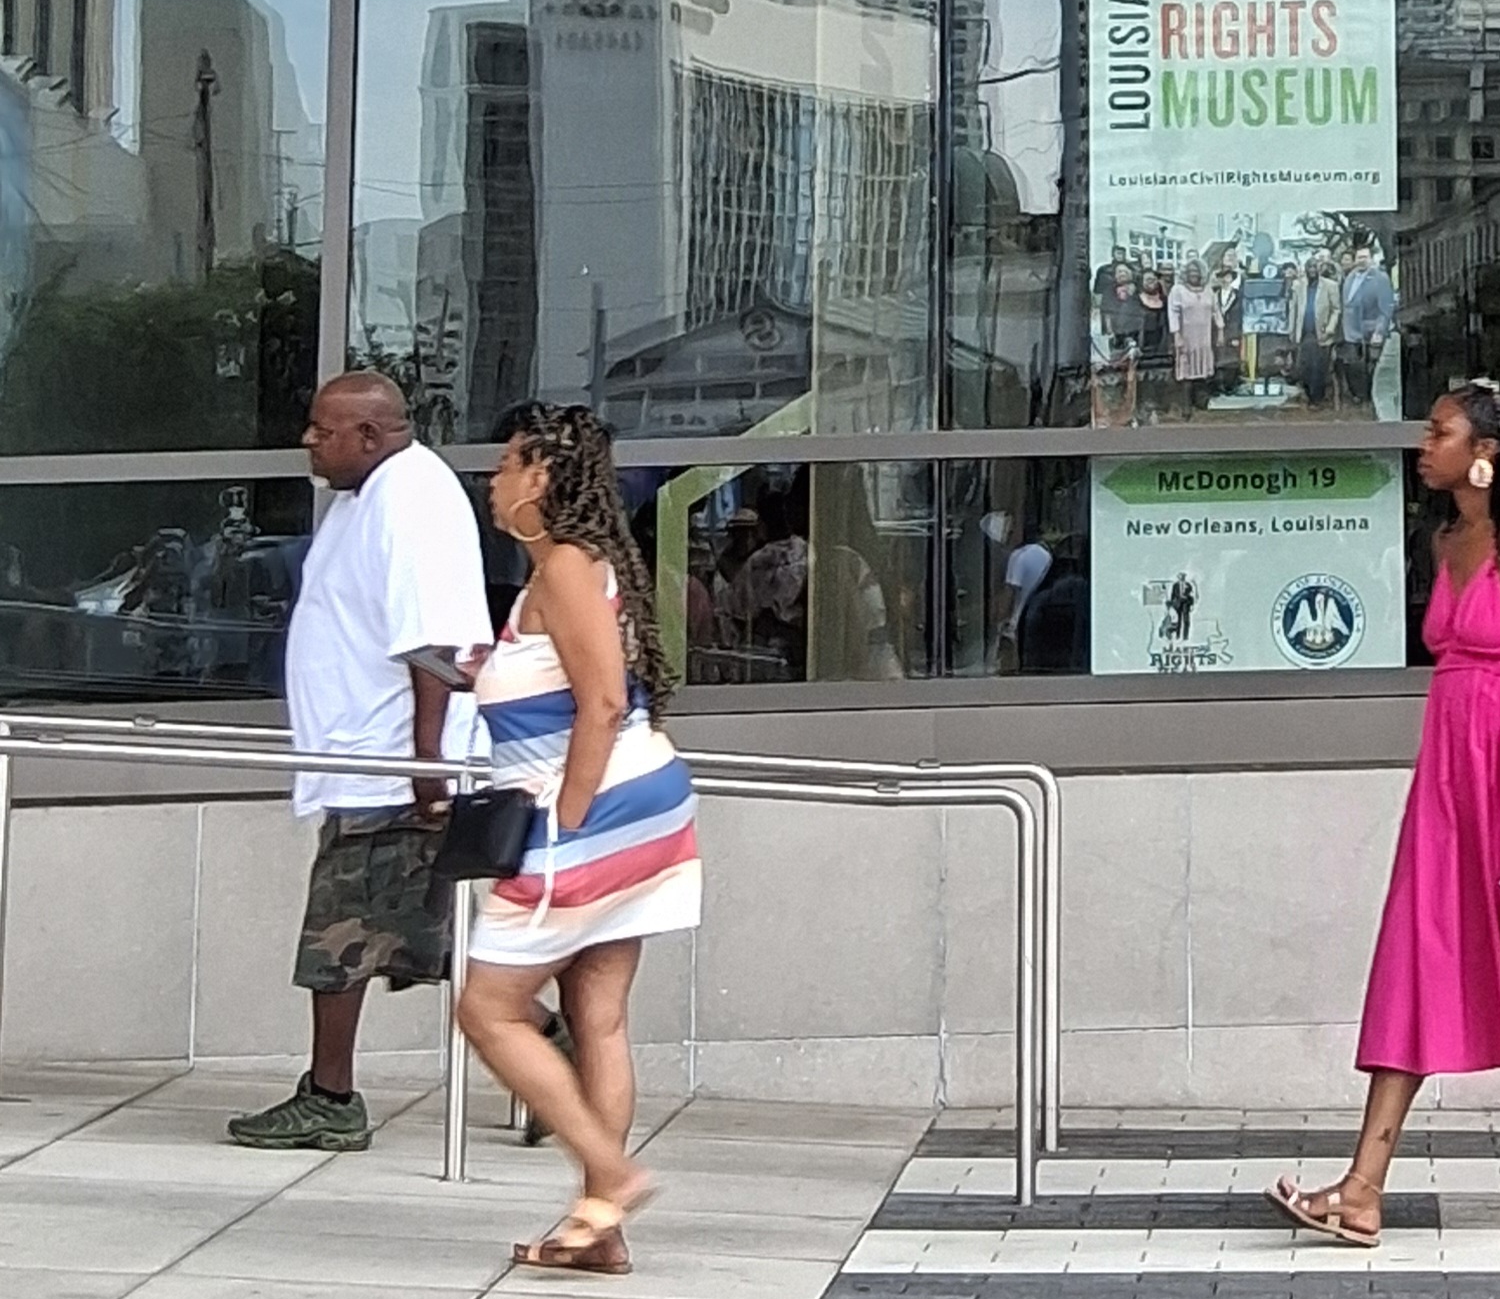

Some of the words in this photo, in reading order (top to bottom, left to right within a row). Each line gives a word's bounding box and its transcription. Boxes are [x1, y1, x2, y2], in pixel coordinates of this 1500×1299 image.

[1161, 66, 1379, 129] MUSEUM
[1108, 169, 1382, 188] LouisianaCivilRightsMuseum.org
[1157, 467, 1298, 495] McDonogh
[1308, 466, 1337, 488] 19
[1126, 519, 1171, 537] New
[1177, 517, 1265, 536] Orleans,
[1270, 514, 1371, 534] Louisiana
